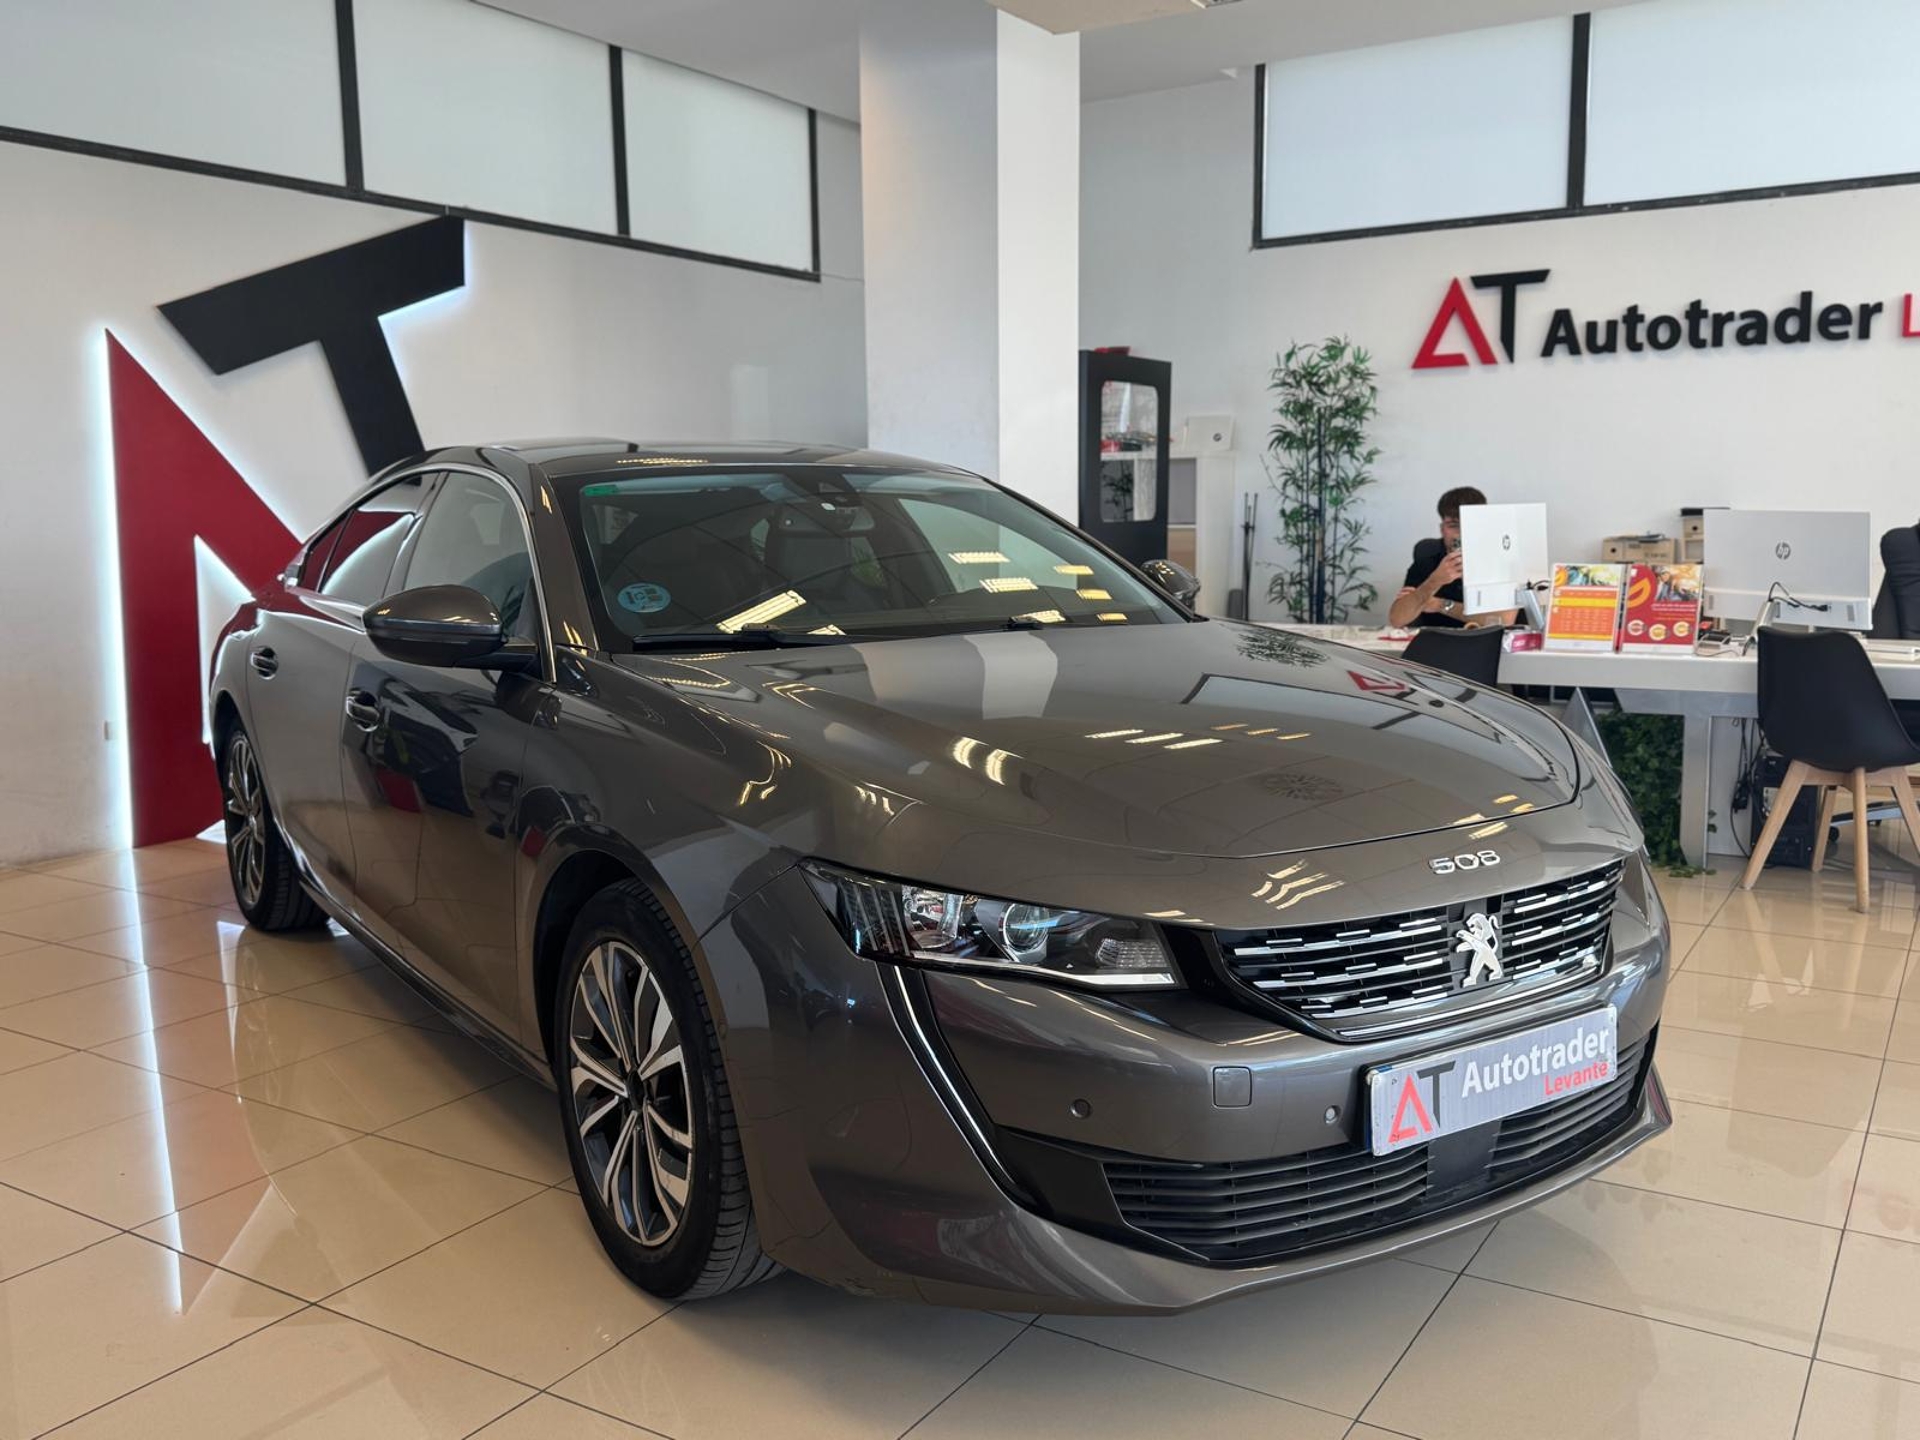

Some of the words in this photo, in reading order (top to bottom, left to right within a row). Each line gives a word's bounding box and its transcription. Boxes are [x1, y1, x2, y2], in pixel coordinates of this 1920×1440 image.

[1540, 291, 1883, 357] Autotrader
[1429, 850, 1500, 875] 508
[1462, 1027, 1610, 1098] Autotrader
[1545, 1061, 1609, 1096] Levante
